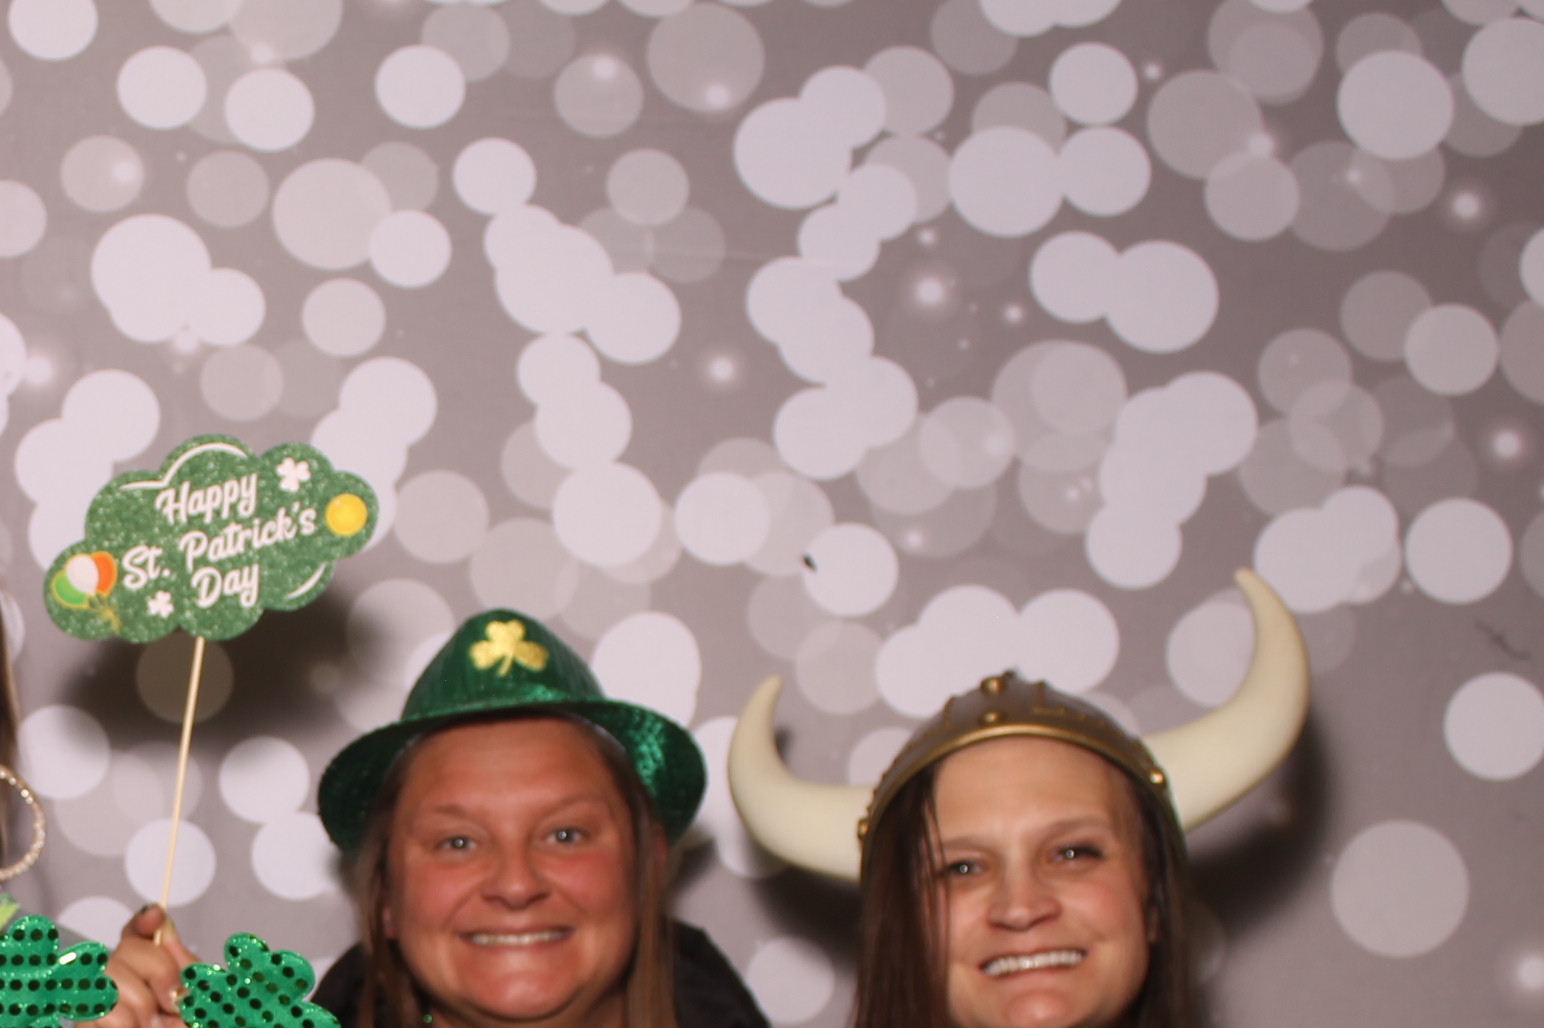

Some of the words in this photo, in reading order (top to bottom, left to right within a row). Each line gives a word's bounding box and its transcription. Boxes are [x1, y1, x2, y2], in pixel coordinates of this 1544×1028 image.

[155, 473, 258, 524] Happy
[122, 544, 172, 591] St.
[178, 501, 317, 573] Patrick's
[191, 564, 259, 608] Day
